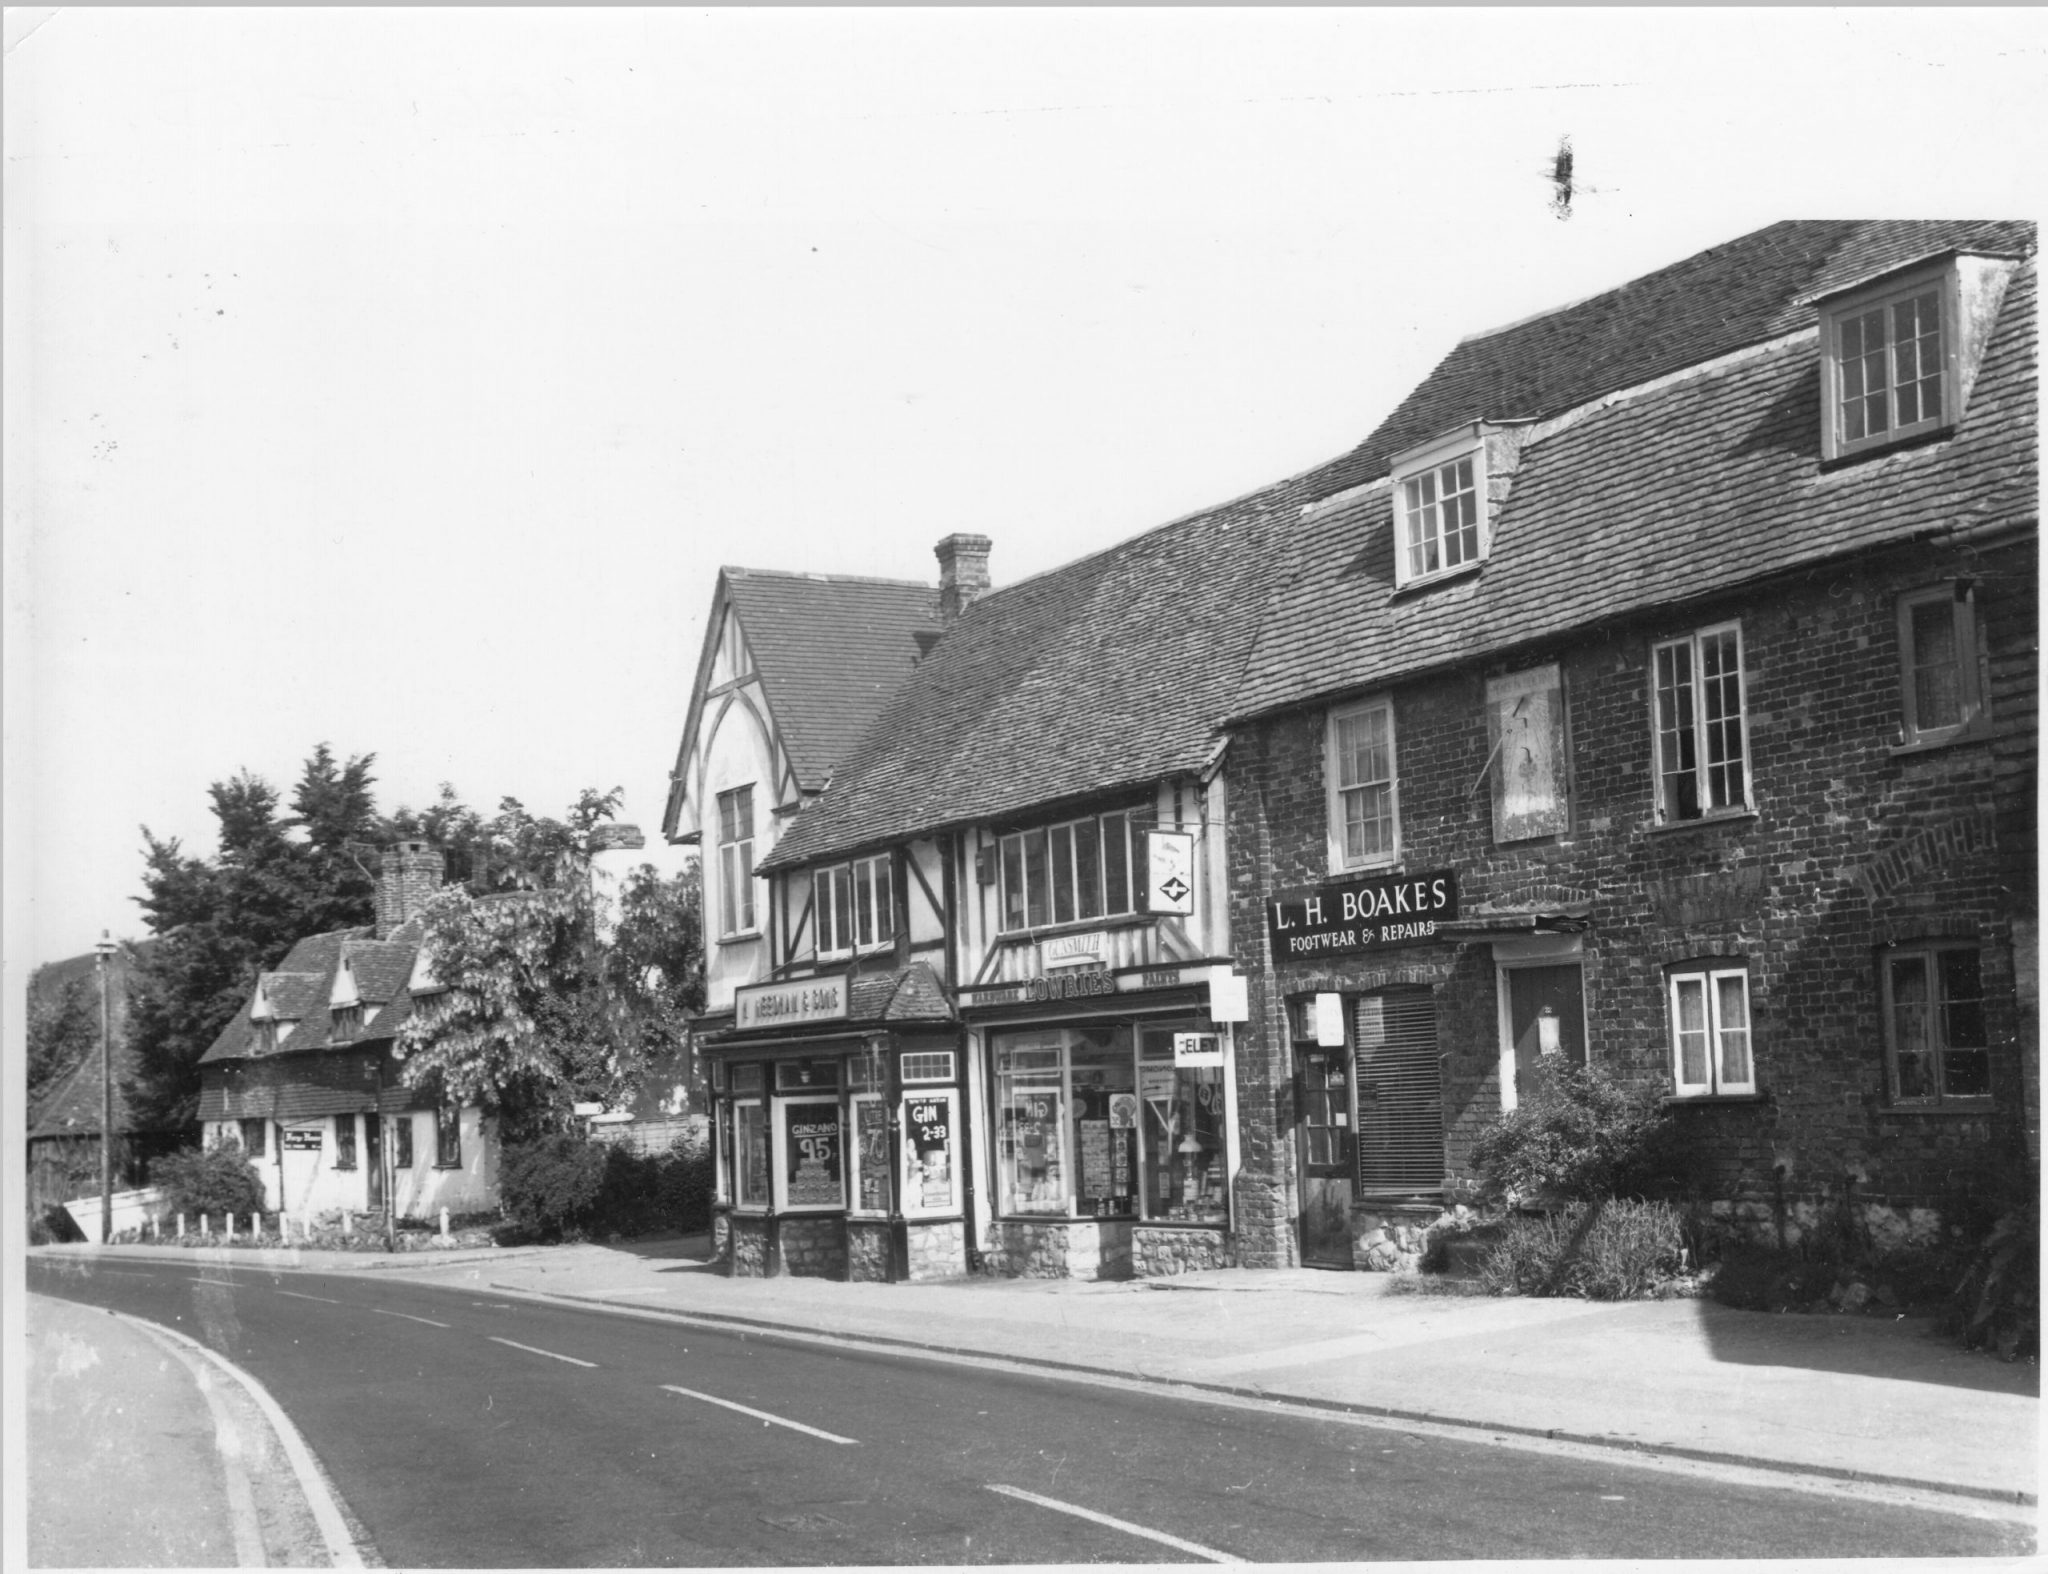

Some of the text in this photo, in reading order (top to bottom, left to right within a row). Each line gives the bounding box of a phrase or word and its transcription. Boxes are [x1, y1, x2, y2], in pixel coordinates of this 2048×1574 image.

[1275, 879, 1446, 929] L. H. BOAKES
[1290, 920, 1435, 952] FOOTWEAR & REPAIRS
[813, 986, 838, 1010] SONS
[1022, 969, 1115, 1003] LOWRIES
[1186, 1037, 1219, 1053] ELEY
[912, 1105, 938, 1123] GIN
[922, 1125, 946, 1141] 2-33
[800, 1137, 830, 1161] 95
